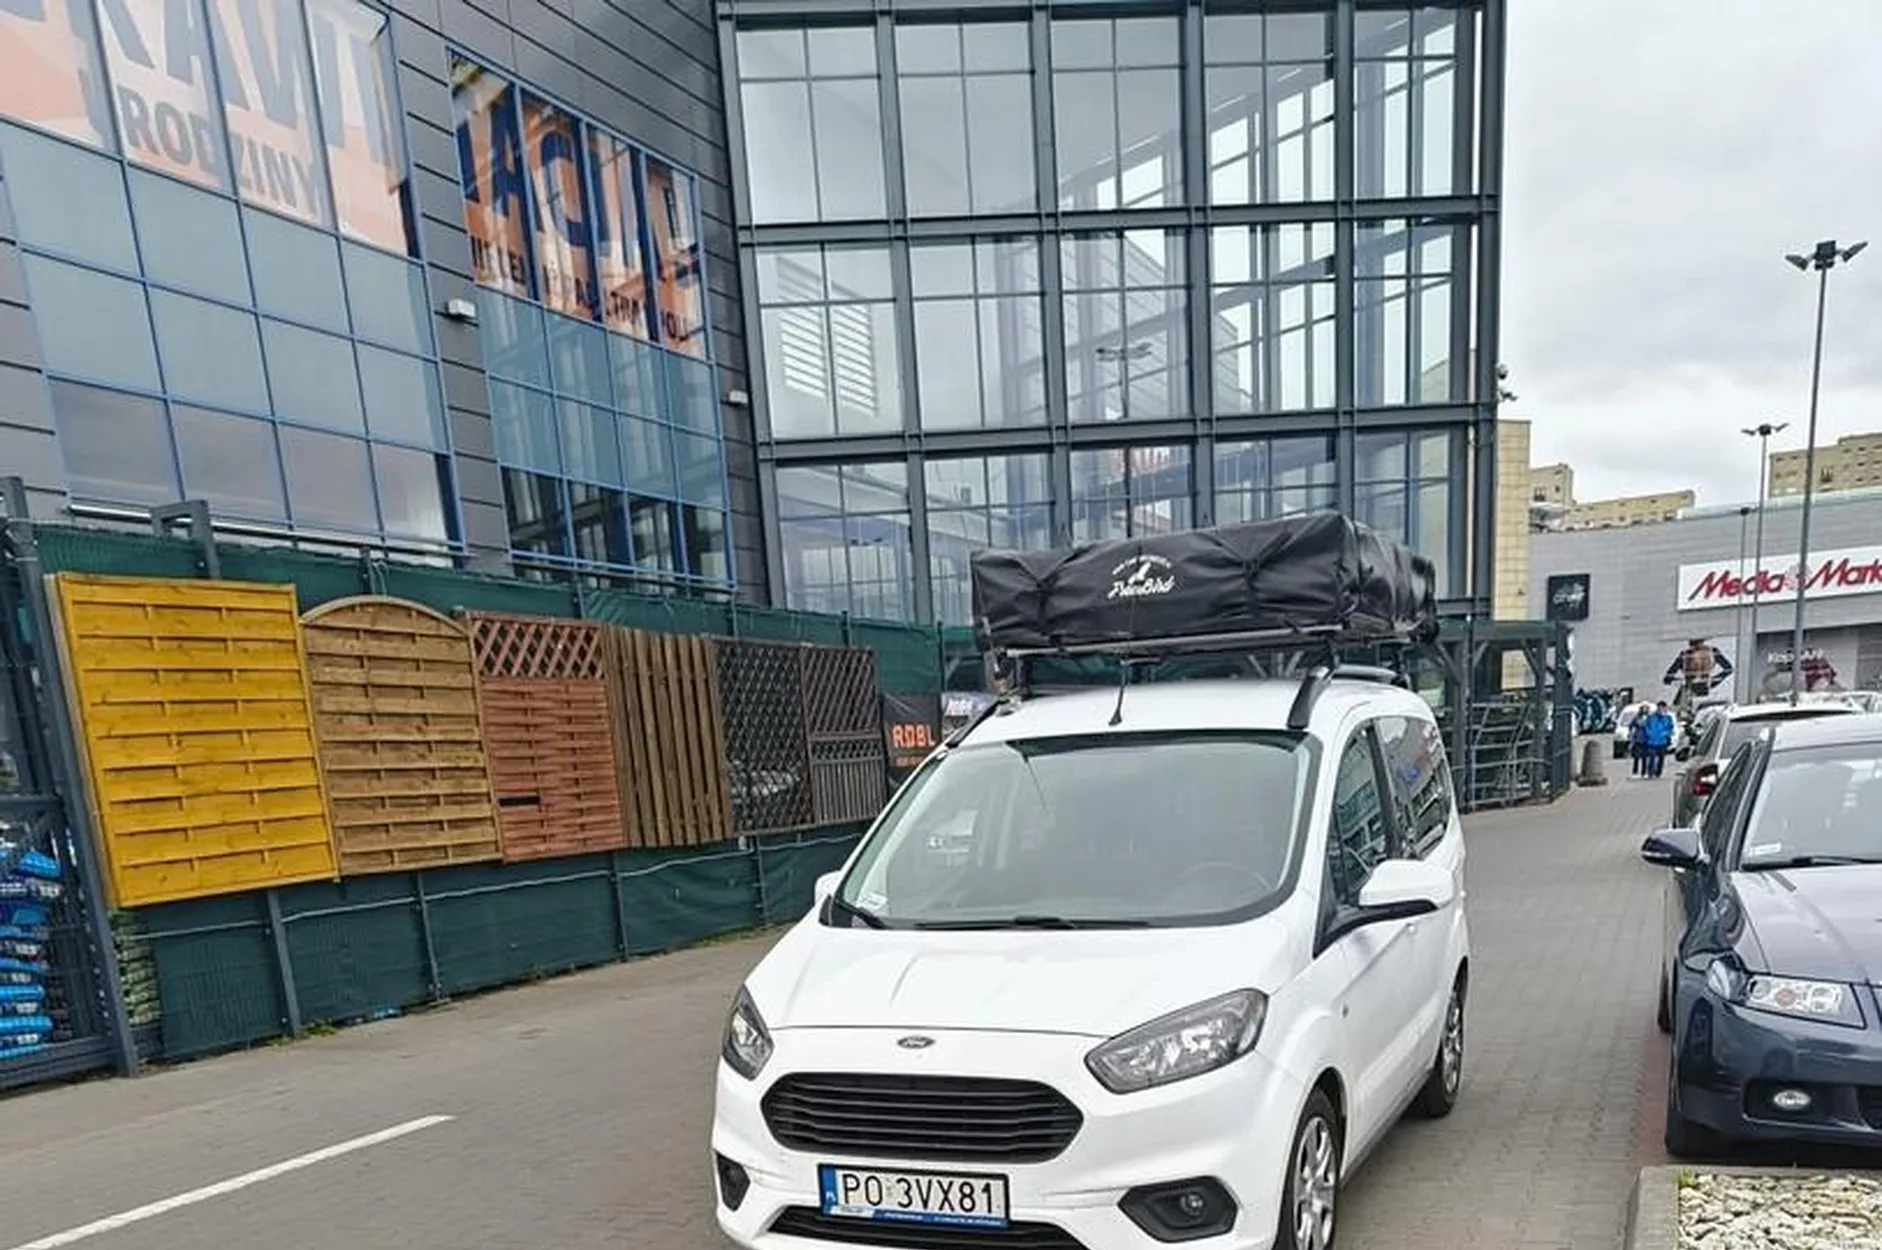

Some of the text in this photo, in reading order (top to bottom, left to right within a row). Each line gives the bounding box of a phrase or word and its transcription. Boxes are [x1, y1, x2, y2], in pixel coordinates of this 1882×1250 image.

[1688, 570, 1785, 600] Media
[842, 1173, 992, 1214] PO 3VX81
